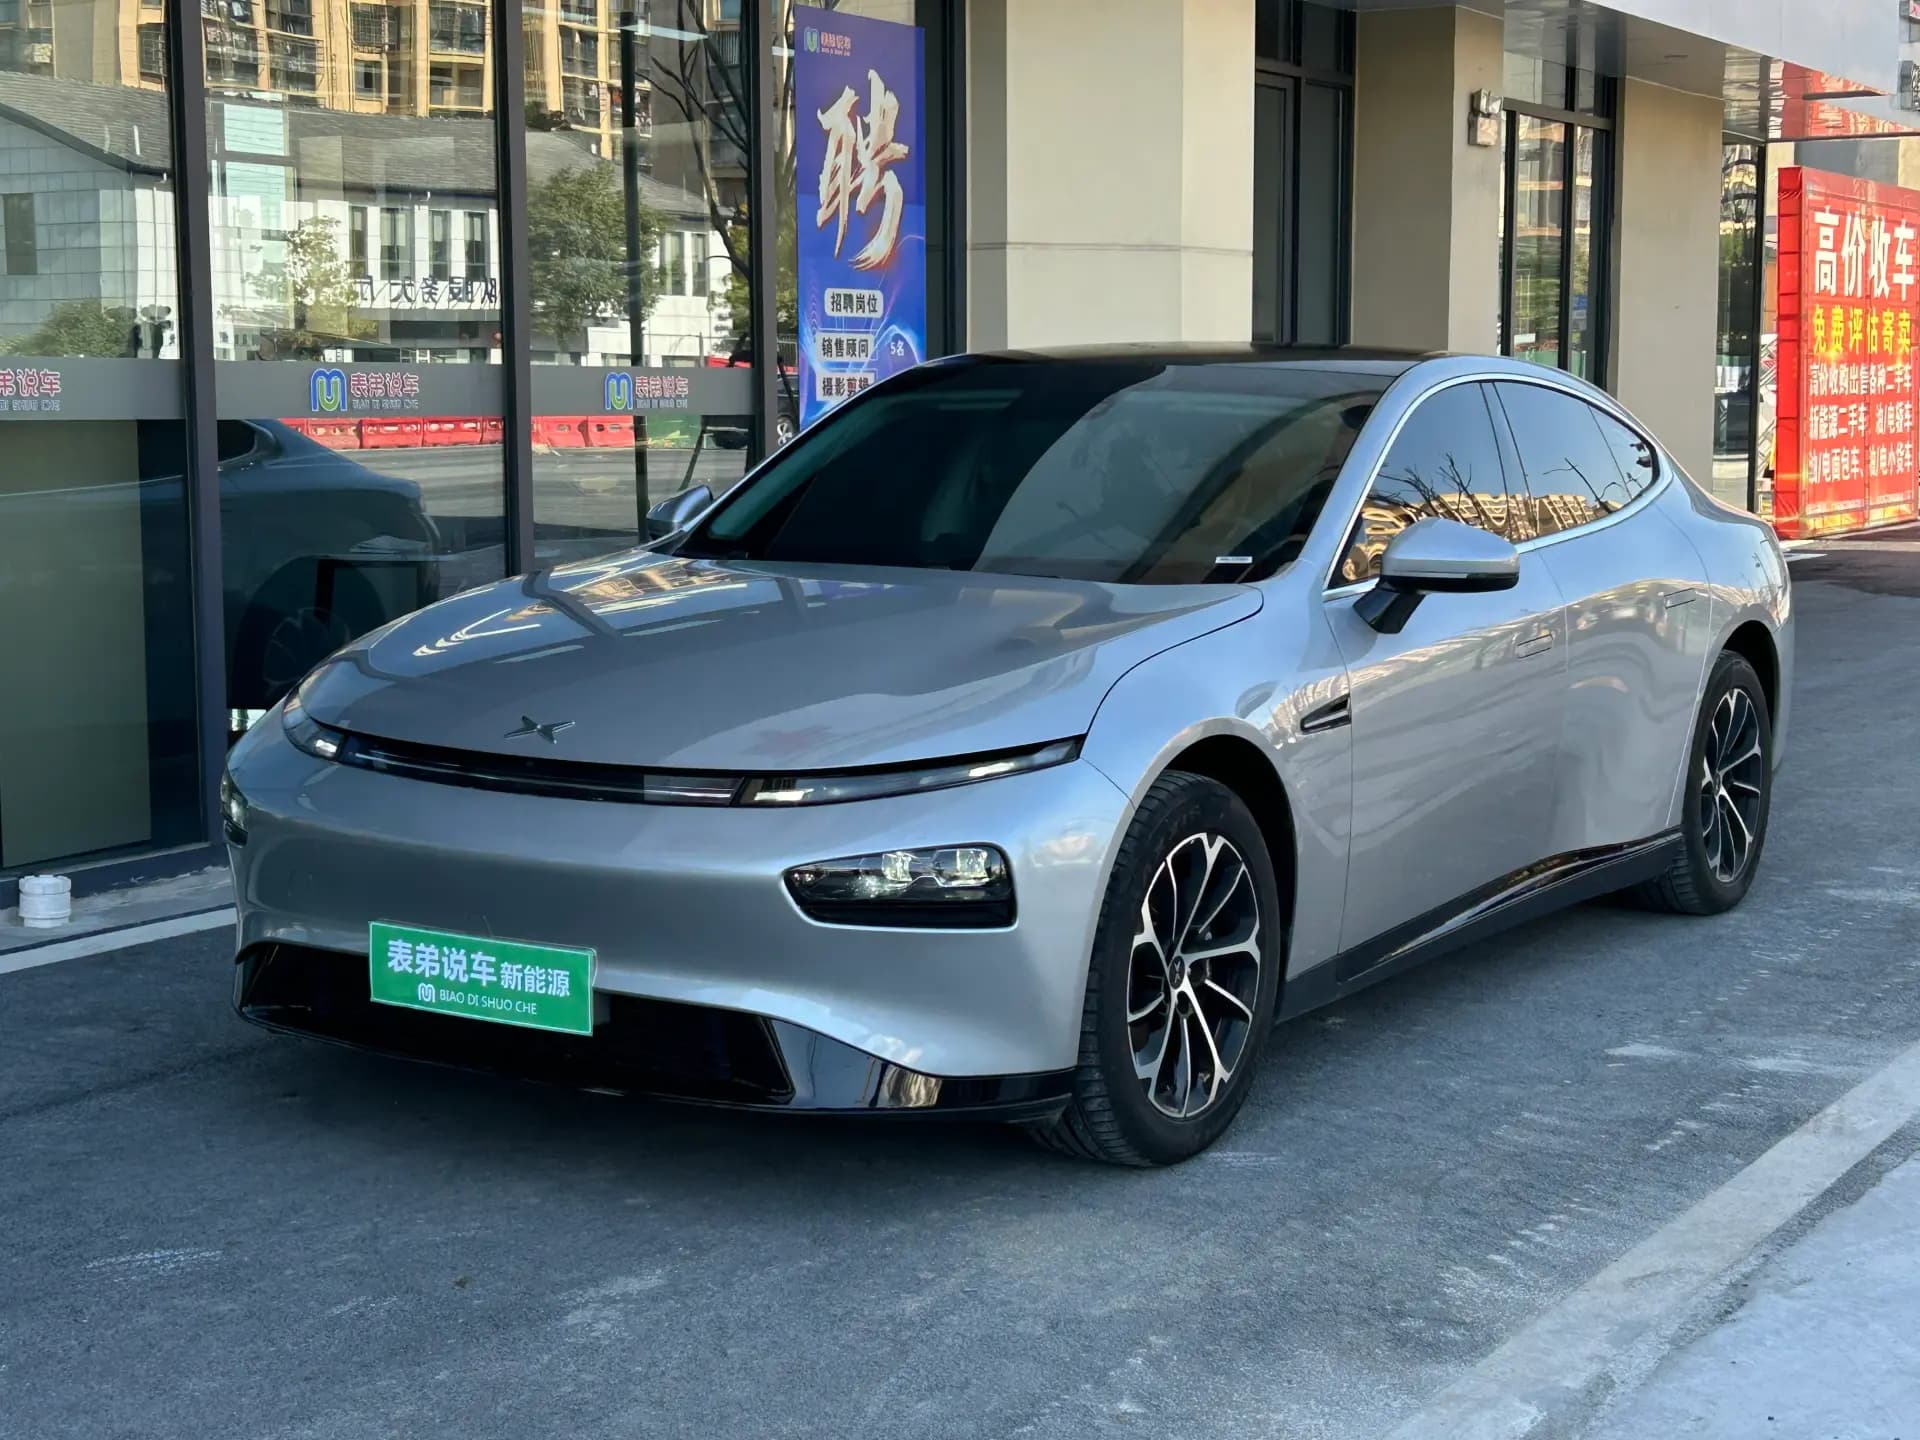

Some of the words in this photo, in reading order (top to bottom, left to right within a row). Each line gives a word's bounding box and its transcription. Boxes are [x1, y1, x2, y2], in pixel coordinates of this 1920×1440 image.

[816, 68, 910, 272] 聘
[1814, 206, 1915, 302] 高价收车
[830, 291, 878, 314] 招聘岗位
[822, 337, 869, 358] 销售顾问
[890, 340, 905, 356] 5名
[350, 372, 419, 398] 表弟说车
[387, 939, 497, 987] 表弟说车
[500, 961, 571, 998] 新能源
[440, 989, 465, 1004] BIAO
[468, 996, 479, 1006] DI
[481, 997, 513, 1012] SHUO
[515, 1000, 537, 1015] CHE
